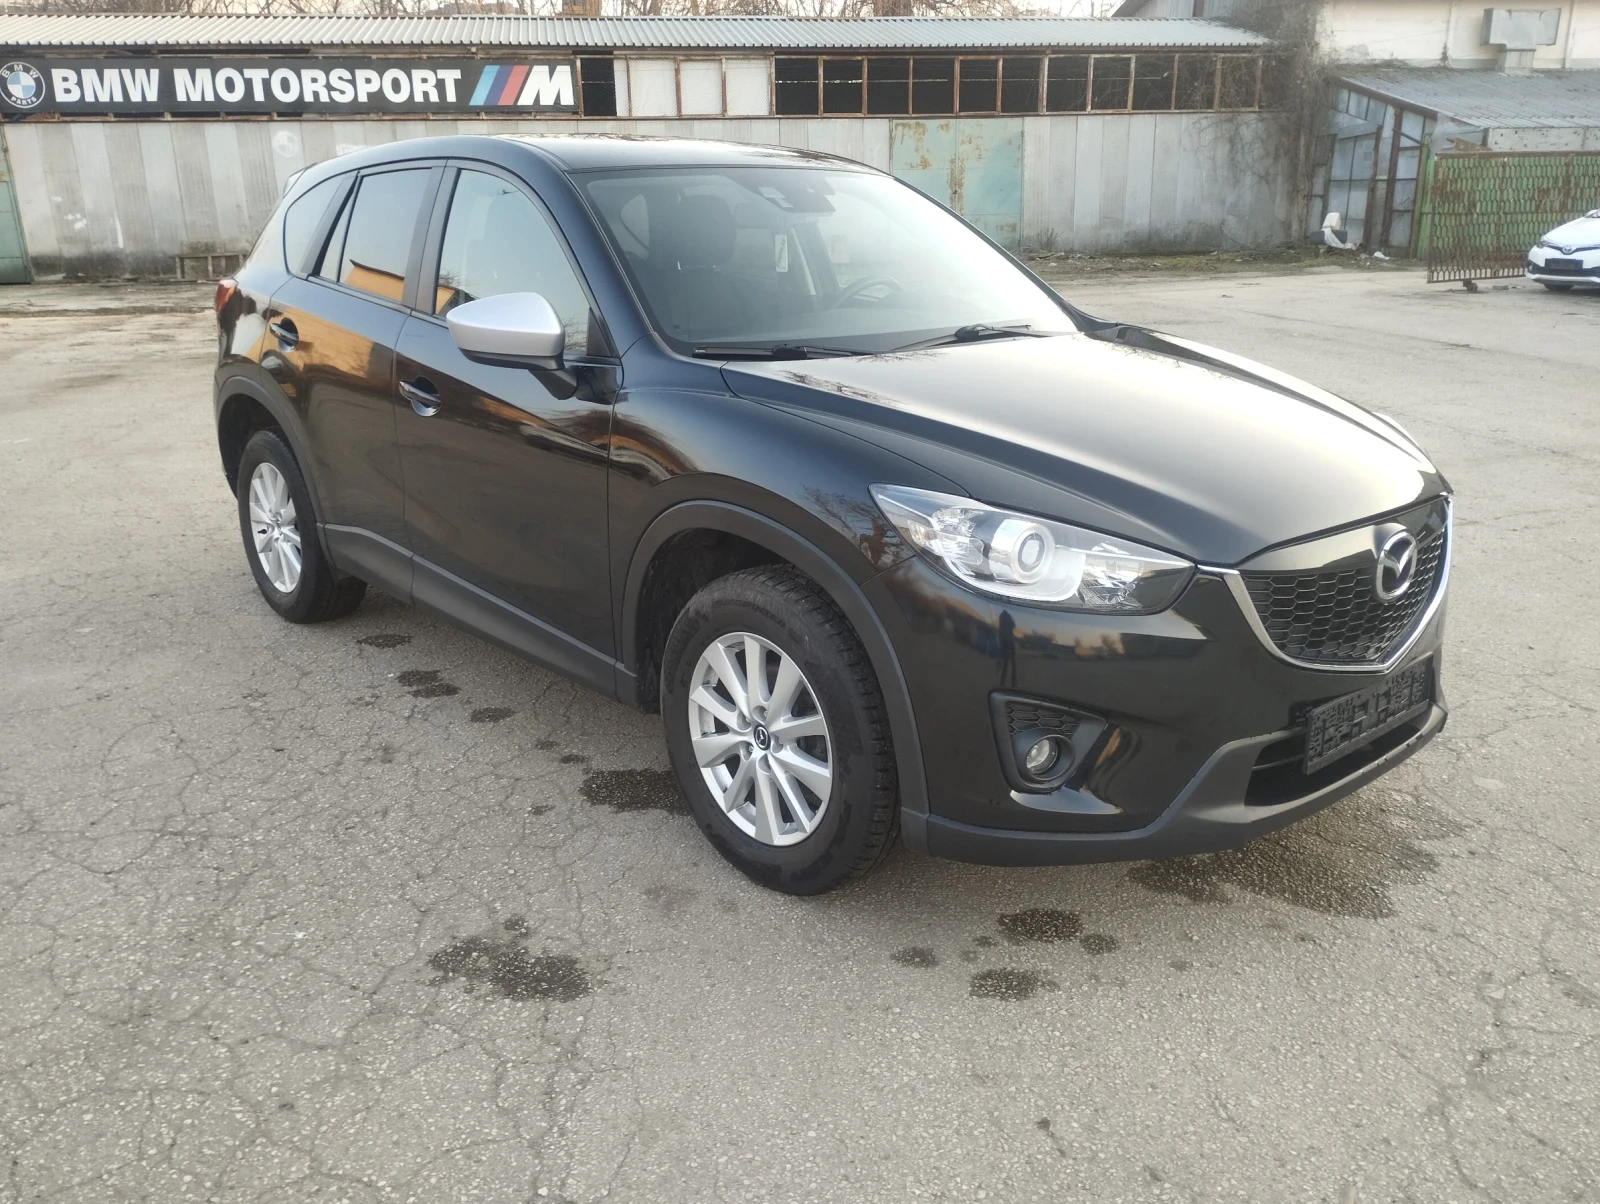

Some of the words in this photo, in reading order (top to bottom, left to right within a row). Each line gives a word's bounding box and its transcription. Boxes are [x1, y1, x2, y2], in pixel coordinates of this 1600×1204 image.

[2, 64, 39, 78] BMW
[51, 68, 159, 103] BMW
[173, 67, 462, 104] MOTORSPORT
[516, 65, 575, 106] M
[11, 96, 37, 105] PARTS
